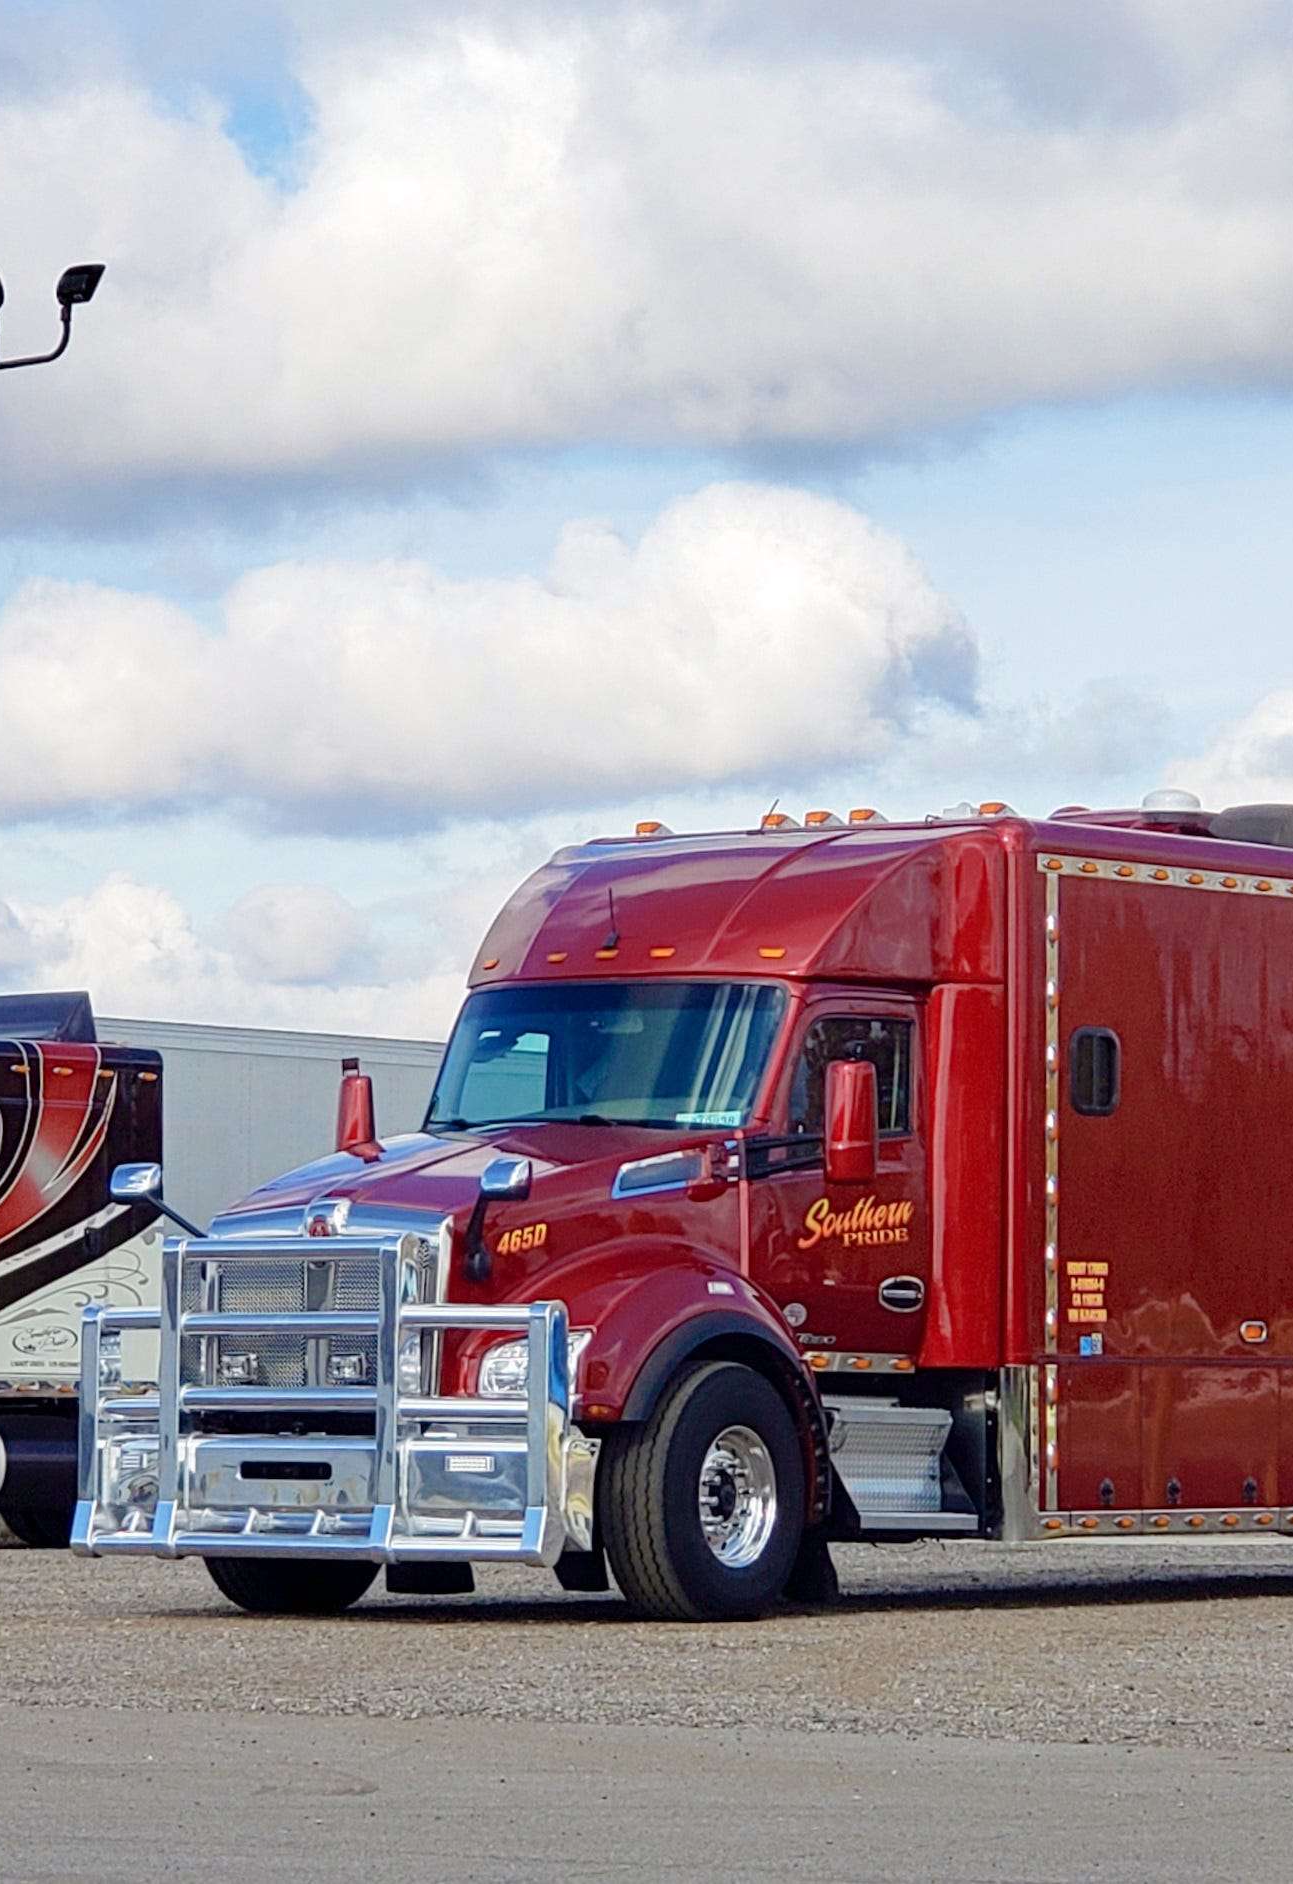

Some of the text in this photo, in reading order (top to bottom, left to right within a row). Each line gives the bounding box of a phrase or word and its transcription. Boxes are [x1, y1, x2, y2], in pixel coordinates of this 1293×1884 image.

[797, 1195, 913, 1249] Southern
[843, 1227, 909, 1247] PRIDE
[497, 1223, 547, 1255] 465D
